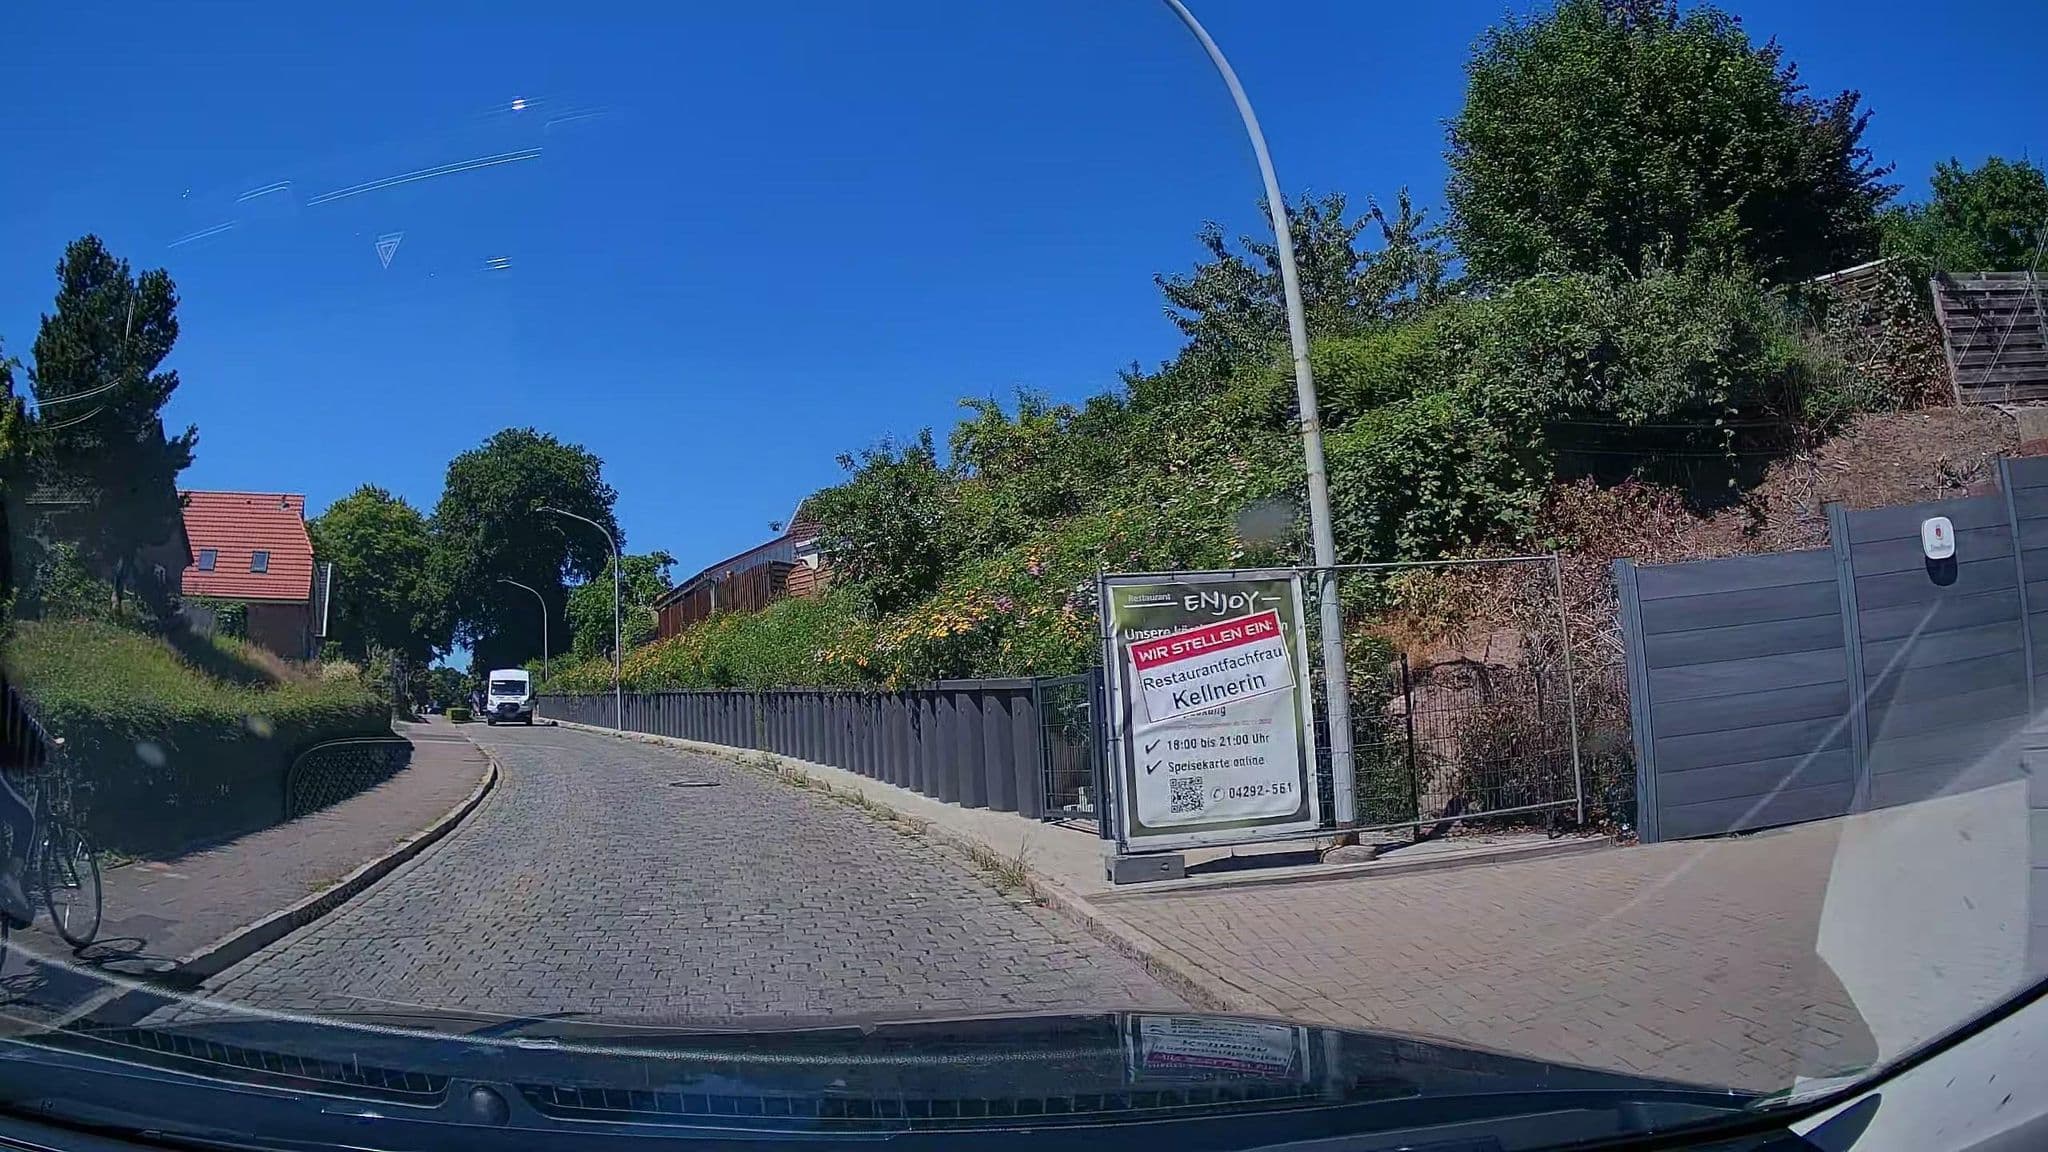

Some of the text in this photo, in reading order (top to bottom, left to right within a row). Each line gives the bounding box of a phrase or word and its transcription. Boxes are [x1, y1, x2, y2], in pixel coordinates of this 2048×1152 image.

[1128, 590, 1260, 616] Restaurant ENJOY
[1125, 628, 1171, 640] Unsere
[1138, 646, 1169, 662] WIR
[1171, 627, 1242, 655] STELLEN
[1245, 619, 1274, 636] EIN:
[1143, 647, 1283, 691] Restaurantfachfrau
[1172, 673, 1268, 709] Kellnerin
[1167, 733, 1270, 751] 18:00 bis 21:00 Uhr
[1168, 756, 1265, 774] Speisekarte online
